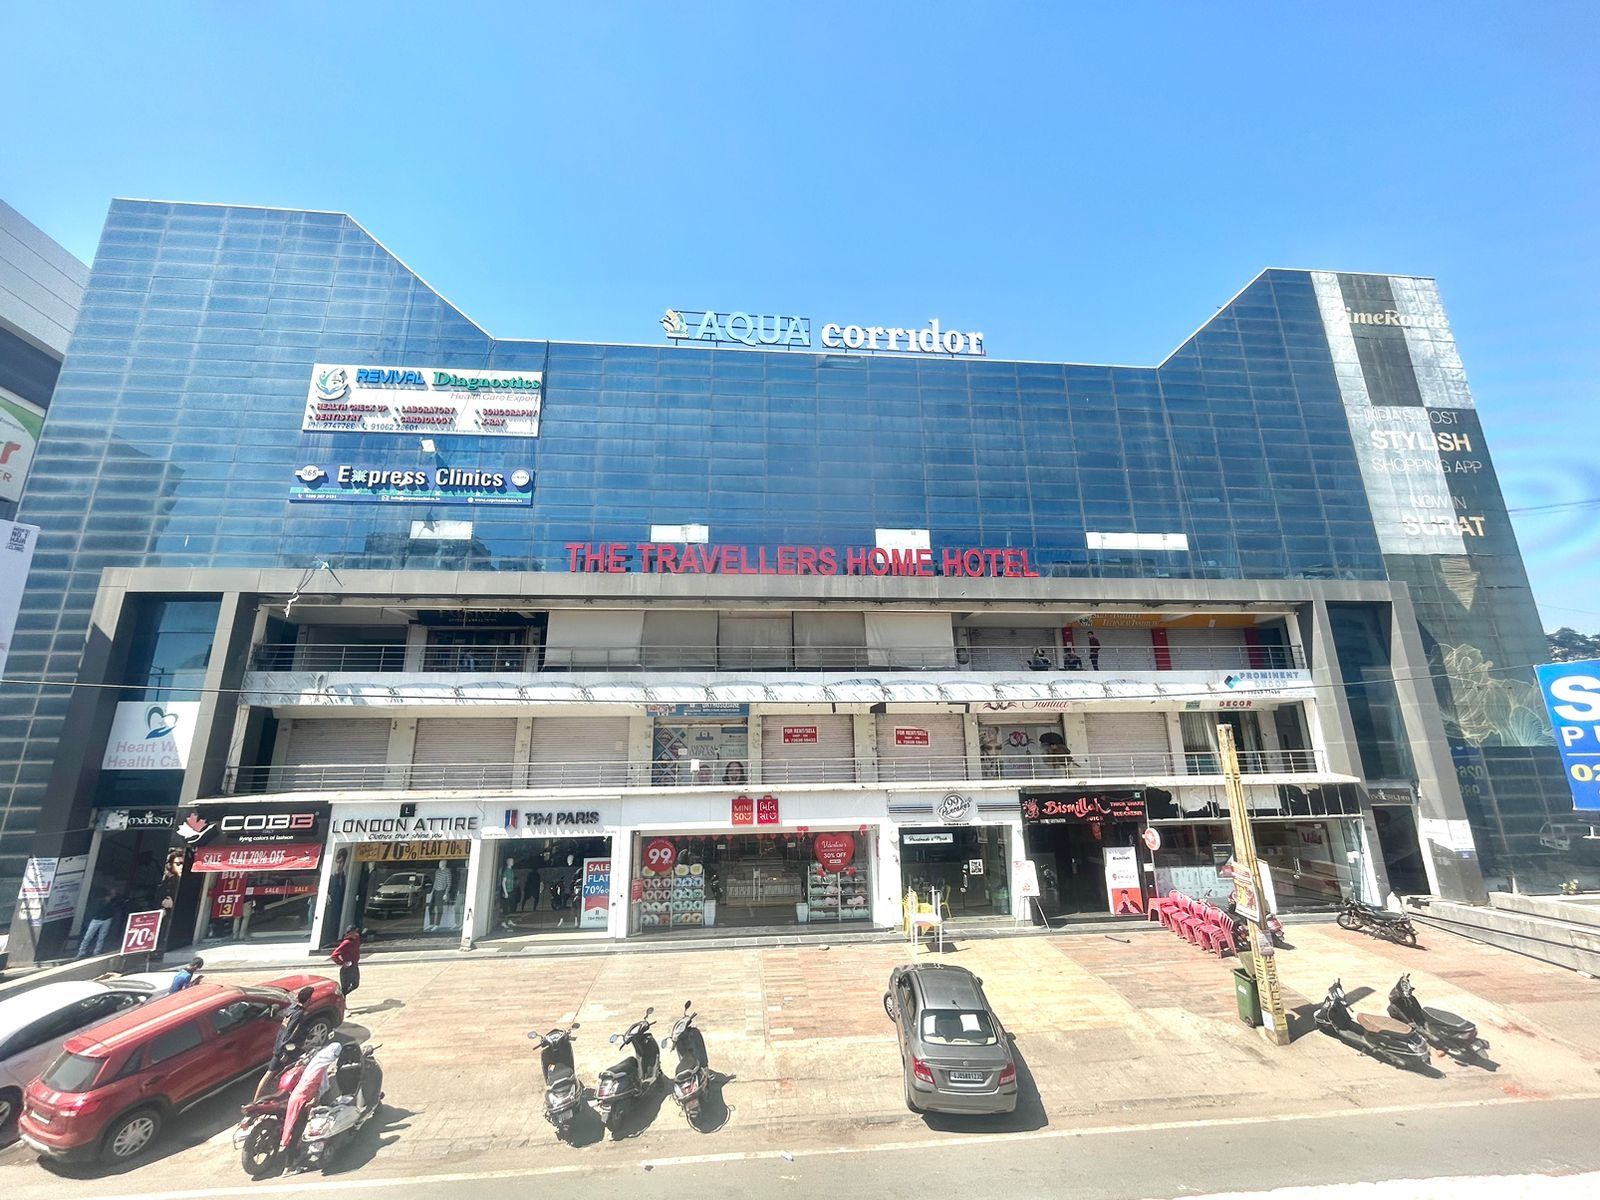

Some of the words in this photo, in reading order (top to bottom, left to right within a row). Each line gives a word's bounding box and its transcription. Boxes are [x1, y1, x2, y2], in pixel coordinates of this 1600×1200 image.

[695, 310, 811, 347] AQUA
[821, 318, 984, 354] corridor
[356, 368, 424, 386] REVIVAL
[432, 371, 541, 390] Diagnostics
[507, 394, 539, 403] Expert
[316, 402, 347, 412] HEALTH
[349, 403, 376, 412] CHECK
[401, 405, 456, 415] LABORATORY
[482, 408, 538, 418] SONOGRAPHY
[315, 412, 363, 423] DENTISTRY
[400, 416, 454, 425] CARDIOLOGY
[1370, 430, 1472, 452] STYLISH
[1371, 458, 1452, 473] SHOPPING
[1455, 460, 1483, 474] APP
[337, 465, 426, 488] Express
[435, 468, 504, 487] Clinics
[1410, 495, 1448, 509] NOW
[1452, 495, 1468, 510] IN
[1401, 515, 1485, 537] SURAT
[565, 543, 627, 573] THE
[636, 543, 837, 576] TRAVELLERS
[846, 547, 934, 577] HOME
[942, 548, 1039, 578] HOTEL
[1239, 671, 1299, 680] PROMINENT
[1254, 680, 1288, 688] DECOR
[1560, 725, 1600, 748] P
[115, 740, 156, 753] Heart
[161, 740, 179, 753] W
[104, 755, 156, 768] Health
[405, 806, 411, 814] L
[1042, 797, 1111, 818] Bismillah
[220, 813, 315, 831] COBB
[331, 818, 408, 834] LONDON
[413, 816, 479, 832] ATTIRE
[525, 812, 553, 826] TIM
[556, 811, 600, 826] PARIS
[411, 832, 430, 840] shine
[382, 841, 417, 860] 70%
[420, 841, 441, 856] FLAT
[445, 841, 462, 855] 70%
[202, 853, 222, 866] SALE
[228, 851, 248, 865] FLAT
[248, 850, 268, 865] 70%
[269, 850, 286, 865] OFF
[648, 847, 672, 865] 99
[588, 863, 610, 872] SALE
[221, 871, 245, 879] BUY
[587, 874, 610, 883] FLAT
[227, 880, 235, 889] 1
[584, 885, 605, 895] 70%
[217, 894, 242, 904] GET
[222, 904, 231, 915] 3
